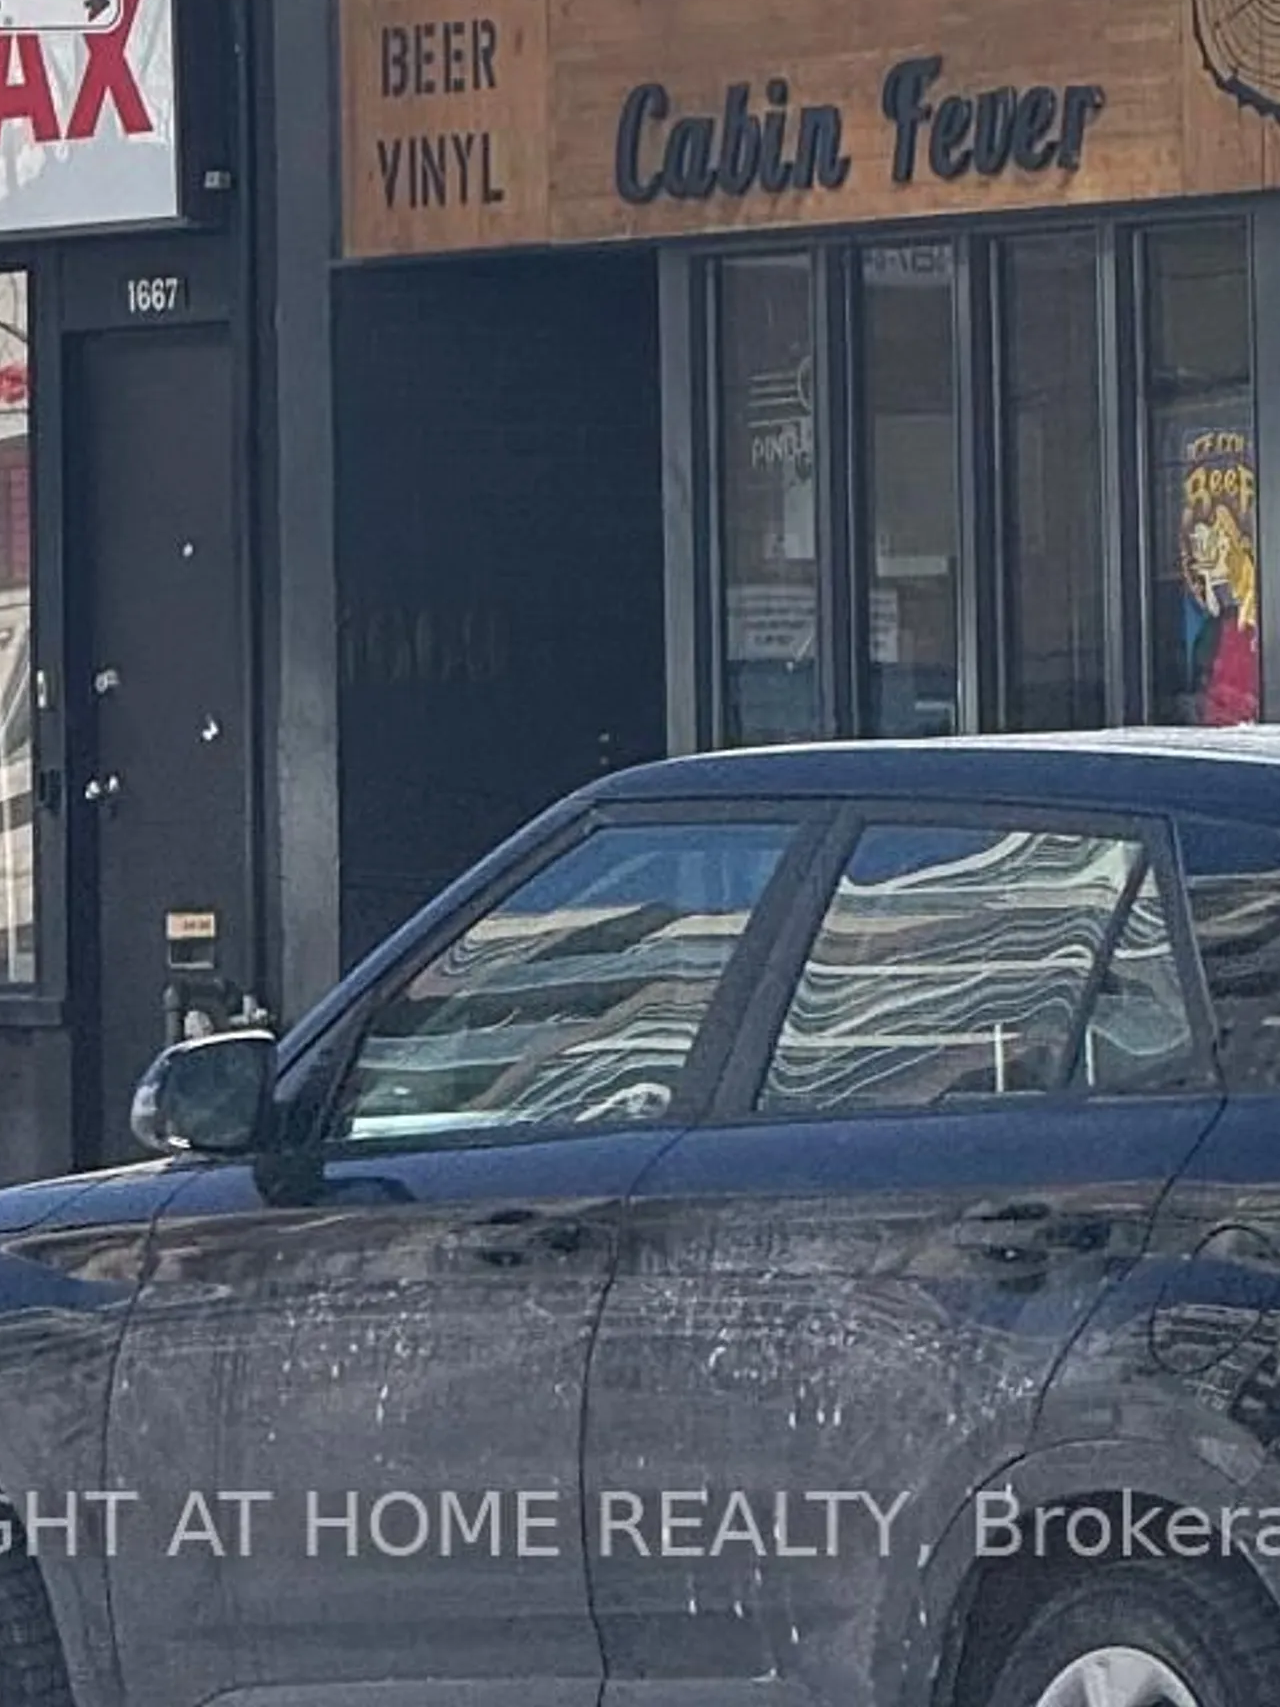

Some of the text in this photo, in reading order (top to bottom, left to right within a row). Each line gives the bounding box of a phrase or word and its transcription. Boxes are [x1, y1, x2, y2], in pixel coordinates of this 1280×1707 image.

[381, 18, 498, 98] BEER
[615, 53, 1106, 205] Cabin Fever
[377, 132, 505, 210] VINYL
[128, 277, 179, 313] 1667
